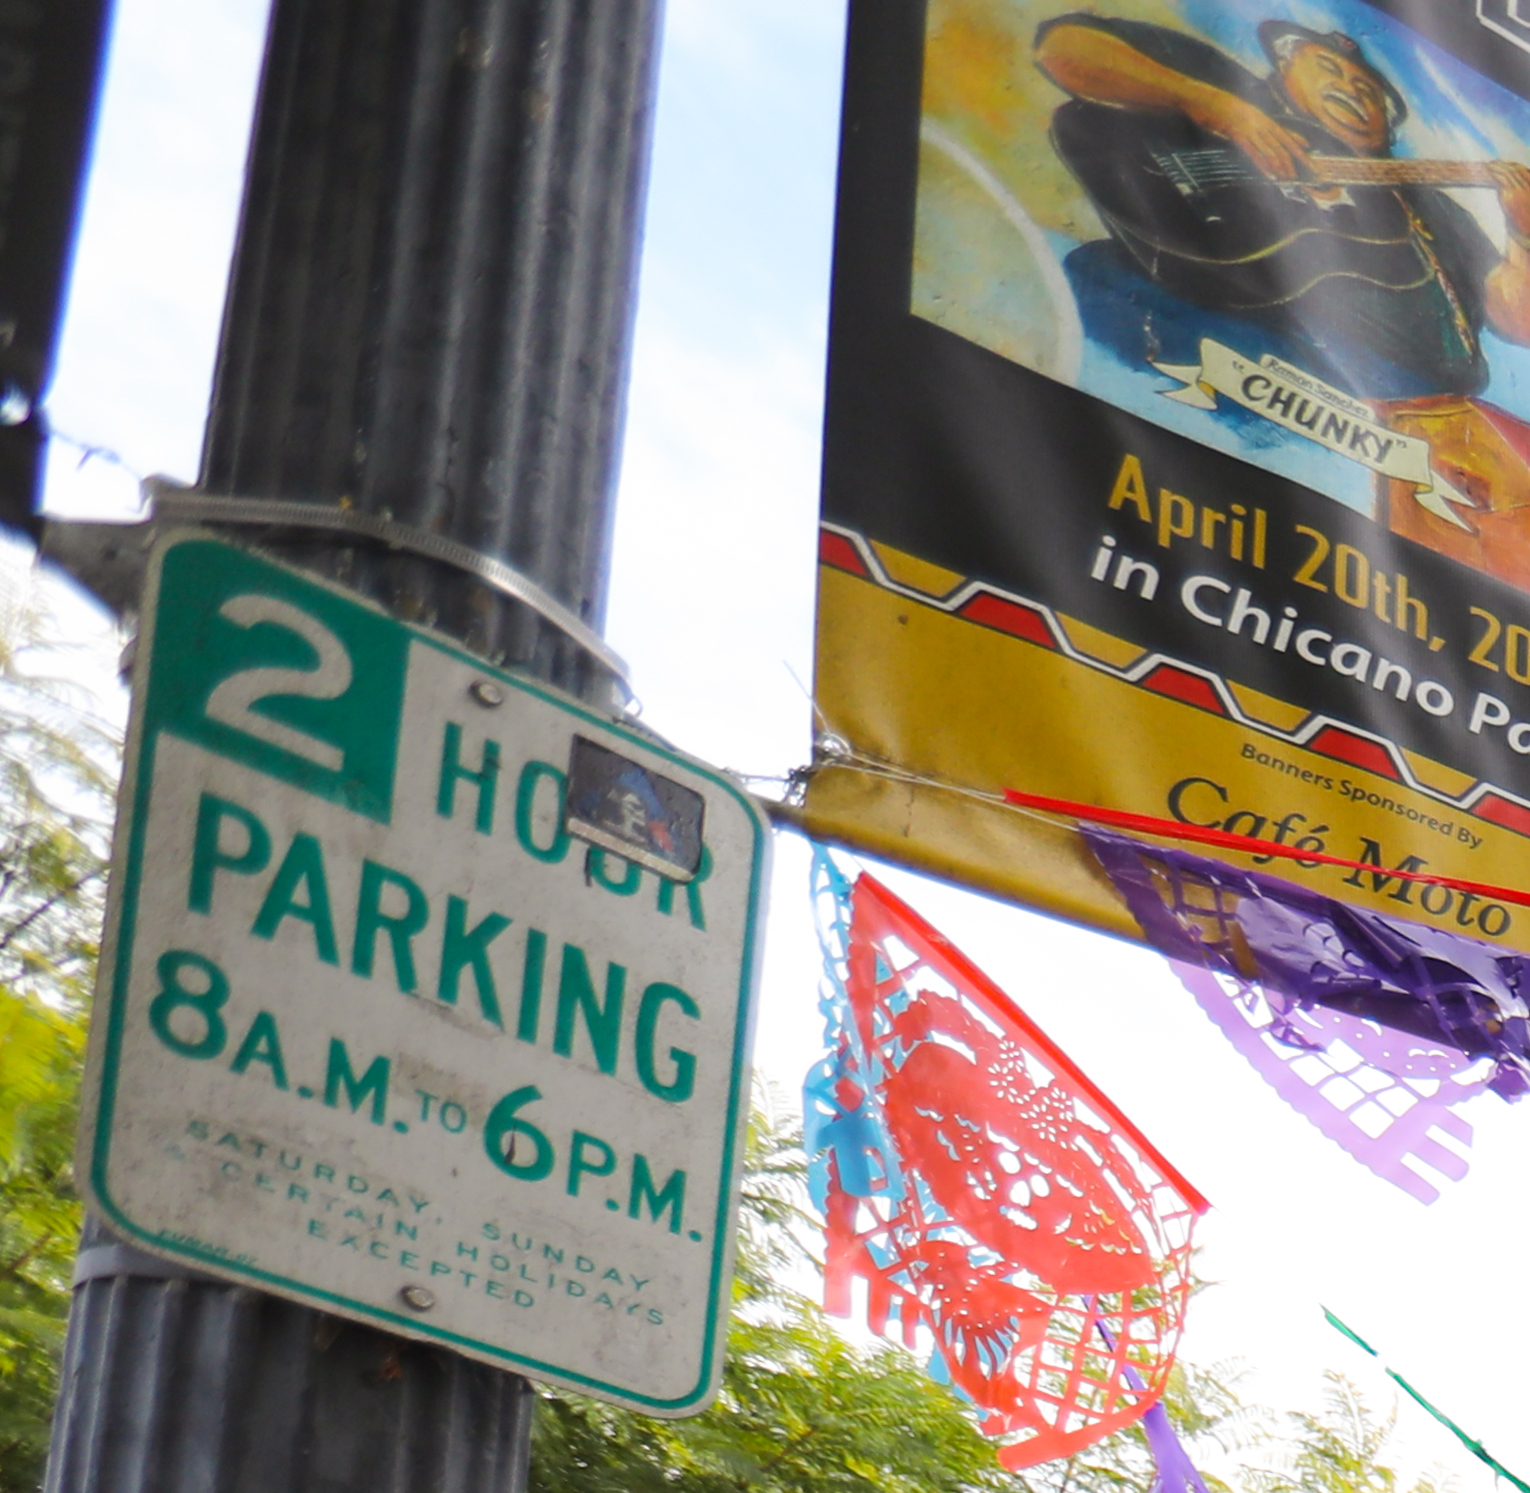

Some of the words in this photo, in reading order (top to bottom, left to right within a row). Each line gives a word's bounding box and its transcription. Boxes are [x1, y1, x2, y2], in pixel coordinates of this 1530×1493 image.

[1090, 535, 1160, 601] in
[1180, 574, 1455, 717] Chicano
[1107, 453, 1267, 569] April
[1293, 523, 1446, 652] 20th,
[202, 593, 354, 772] 2
[1166, 776, 1330, 868] Café
[1342, 836, 1512, 937] Moto
[1240, 743, 1333, 791] Banners
[1338, 779, 1454, 836] Sponsored
[1457, 826, 1483, 849] By
[186, 791, 701, 1106] PARKING
[416, 1089, 468, 1135] TO
[220, 1159, 421, 1242] CERTAIN
[456, 1239, 665, 1327] HOLIDAYS
[306, 1218, 537, 1310] EXCEPTED
[482, 1221, 650, 1291] SUNDAY
